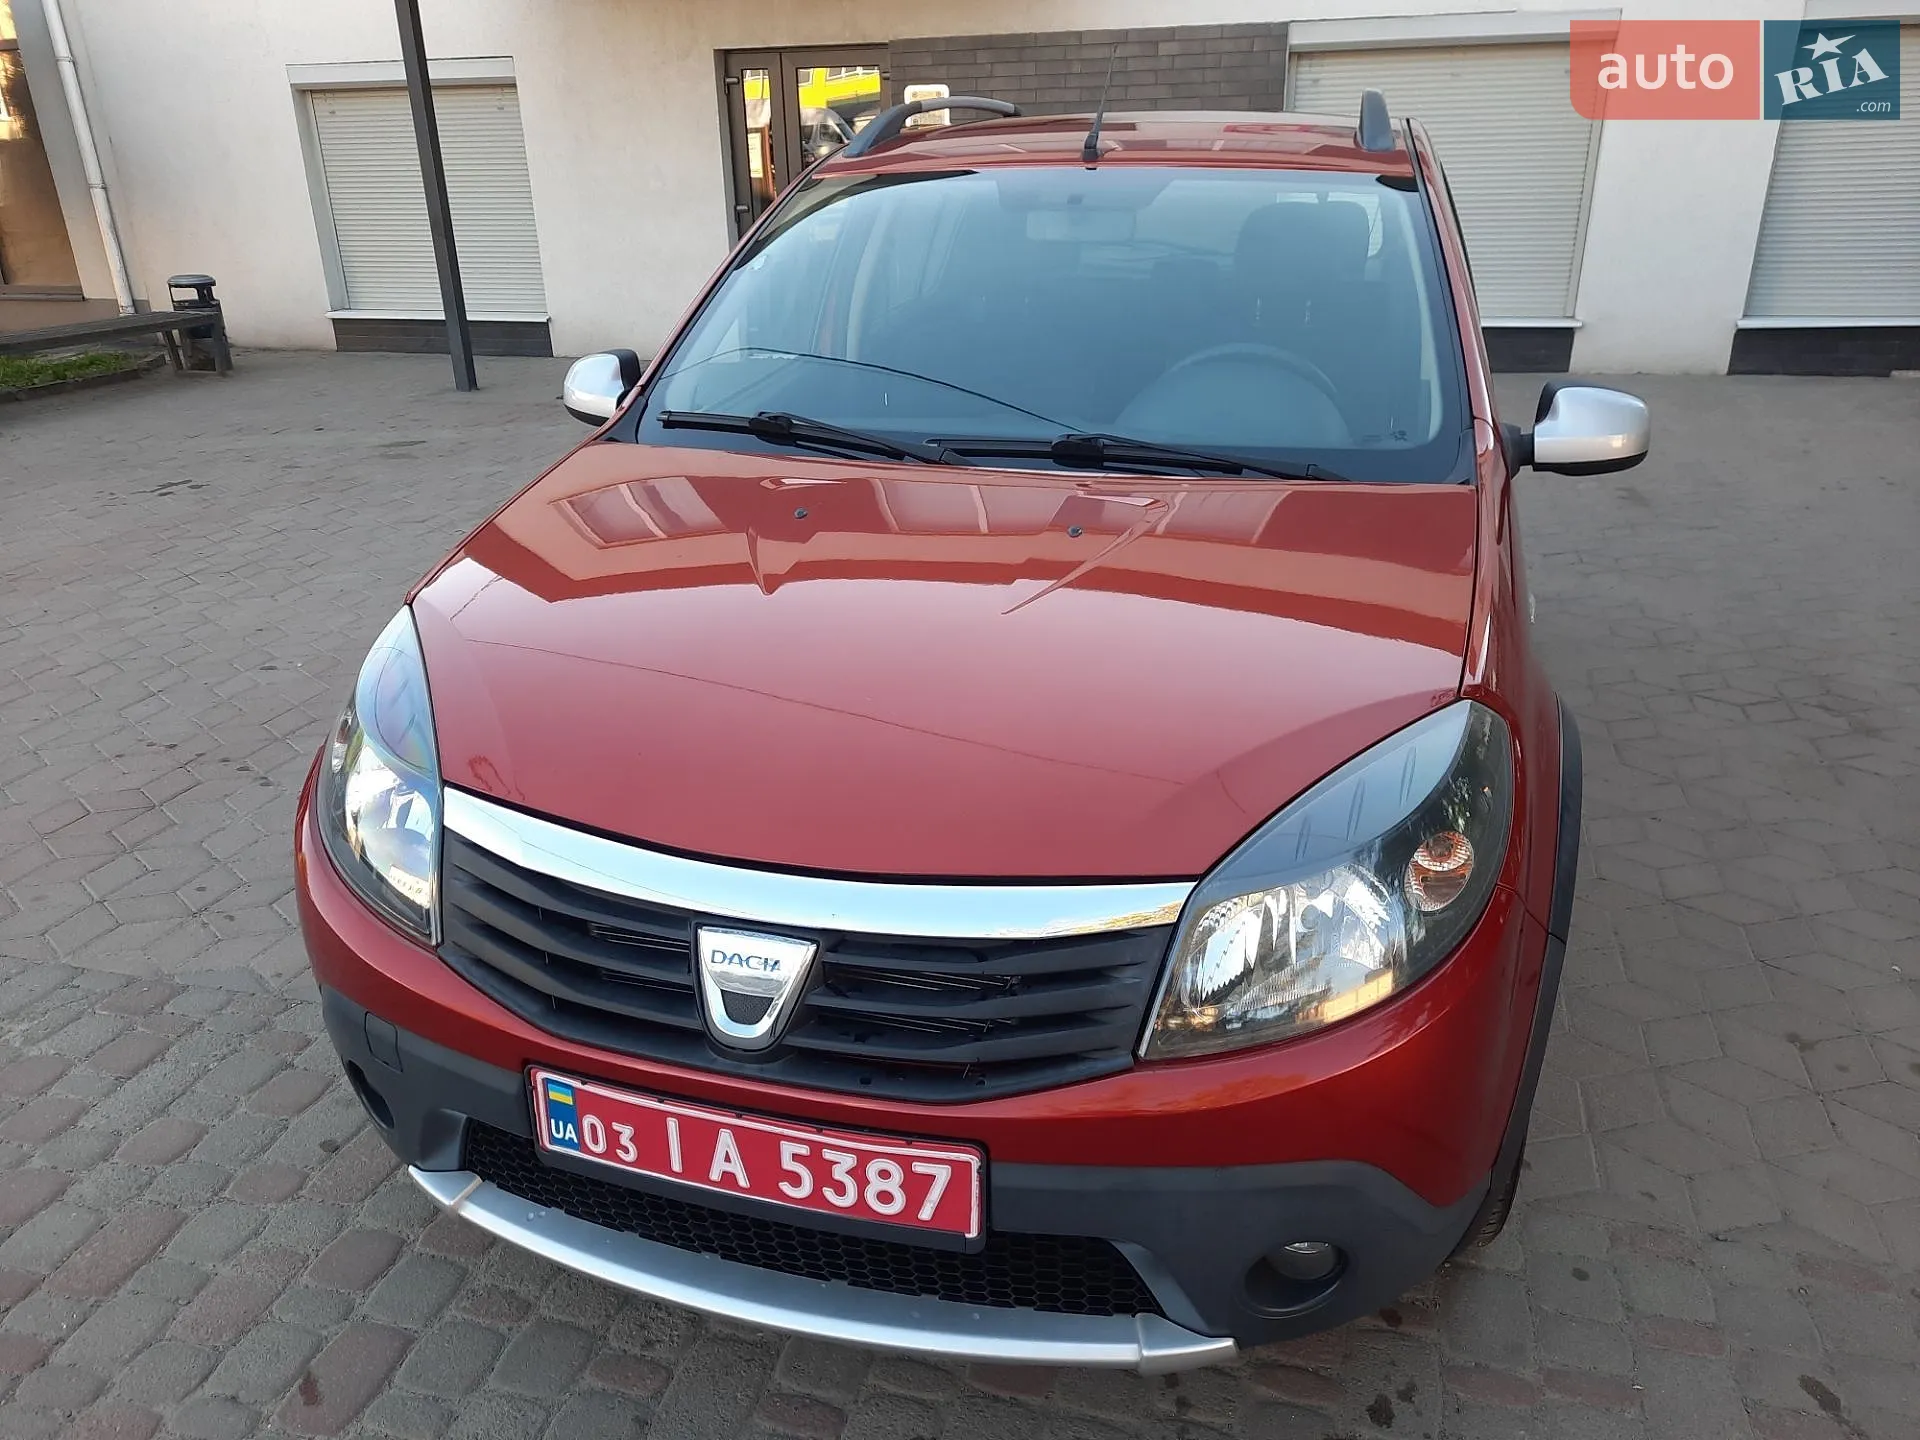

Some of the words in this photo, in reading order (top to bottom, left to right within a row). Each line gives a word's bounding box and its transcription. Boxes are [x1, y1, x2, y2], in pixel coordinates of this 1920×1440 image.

[711, 949, 782, 972] DACIA
[550, 1118, 578, 1143] UA
[582, 1114, 638, 1163] 03
[778, 1140, 952, 1221] 5387
